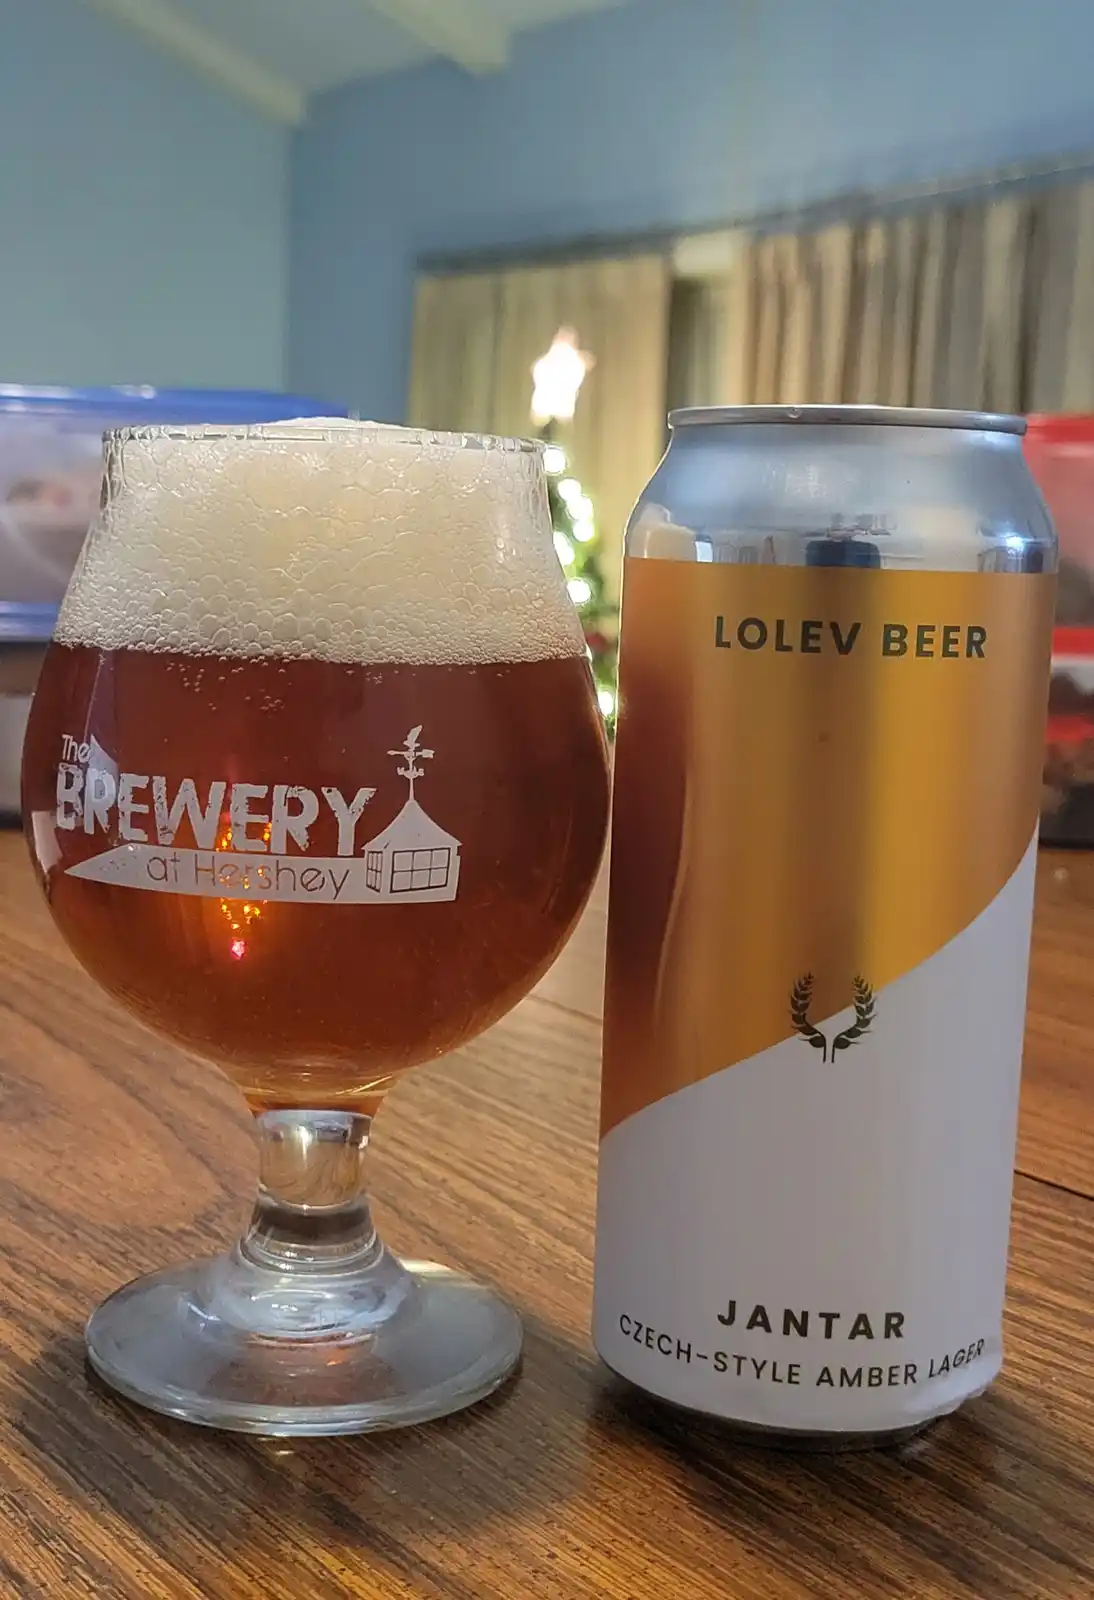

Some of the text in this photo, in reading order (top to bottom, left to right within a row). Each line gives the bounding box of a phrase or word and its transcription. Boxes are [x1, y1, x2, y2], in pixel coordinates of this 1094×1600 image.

[715, 616, 987, 659] LOLEV BEER
[62, 734, 91, 763] The
[56, 762, 377, 856] BREWERY
[146, 851, 350, 900] at Hershey
[717, 1300, 905, 1340] JANTAR
[619, 1314, 985, 1388] CZECH-STYLE AMBER LAGER
